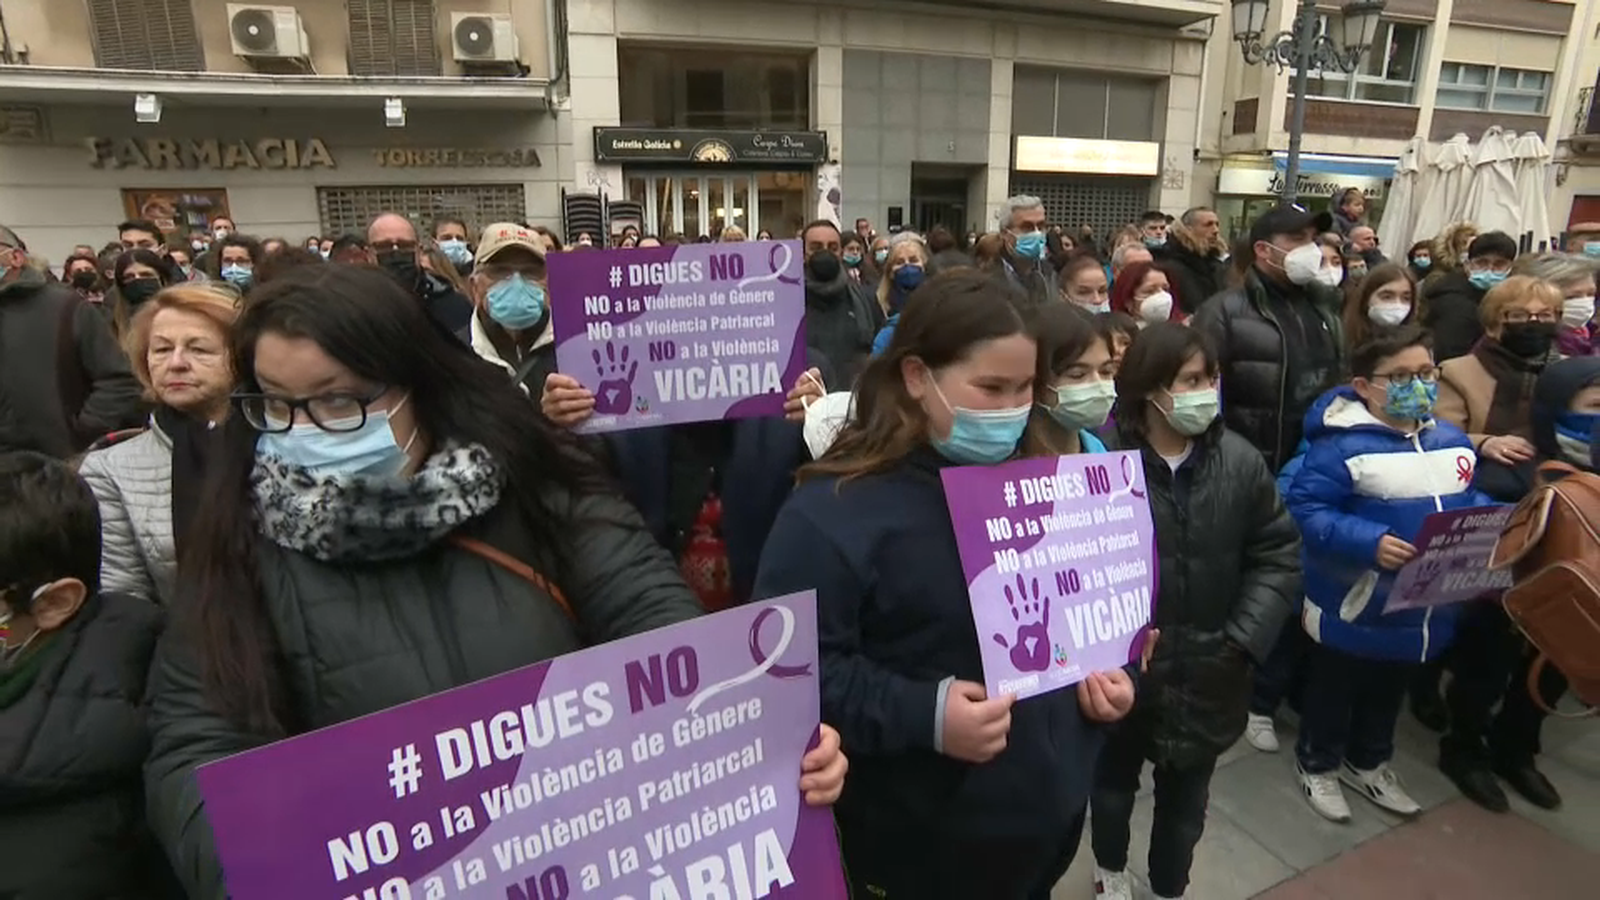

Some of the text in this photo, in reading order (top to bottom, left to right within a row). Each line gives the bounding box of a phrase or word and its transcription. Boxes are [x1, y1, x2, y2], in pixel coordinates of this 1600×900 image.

[86, 137, 336, 170] FARMACIA
[612, 138, 672, 149] Estrella Galicia
[628, 260, 703, 287] DIGUES
[709, 253, 744, 281] NO
[584, 296, 611, 316] NO
[615, 301, 624, 313] a
[627, 297, 640, 313] la
[644, 291, 706, 312] Violència
[709, 290, 726, 306] de
[587, 312, 775, 341] NO a la Violència Patriarcal
[649, 337, 779, 362] NO a la Violència
[654, 358, 783, 403] VICÀRIA
[1020, 472, 1086, 506] DIGUES
[1085, 464, 1111, 496] NO
[985, 517, 1012, 542] NO
[1015, 521, 1024, 538] a
[1026, 517, 1040, 535] la
[1040, 510, 1092, 534] Violència
[1093, 507, 1105, 524] de
[993, 548, 1020, 574] NO
[1023, 553, 1032, 570] a
[1034, 550, 1047, 568] la
[1048, 541, 1098, 565] Violència
[1055, 558, 1147, 597] NO a la Violència
[1064, 585, 1151, 649] VICÀRIA
[387, 645, 700, 799] # DIGUES NO
[327, 697, 763, 882] NO a la Violència de Gènere
[342, 737, 764, 900] O a la Violència Patriarcal
[580, 862, 601, 892] a
[608, 845, 640, 879] la
[644, 783, 778, 861] Violència
